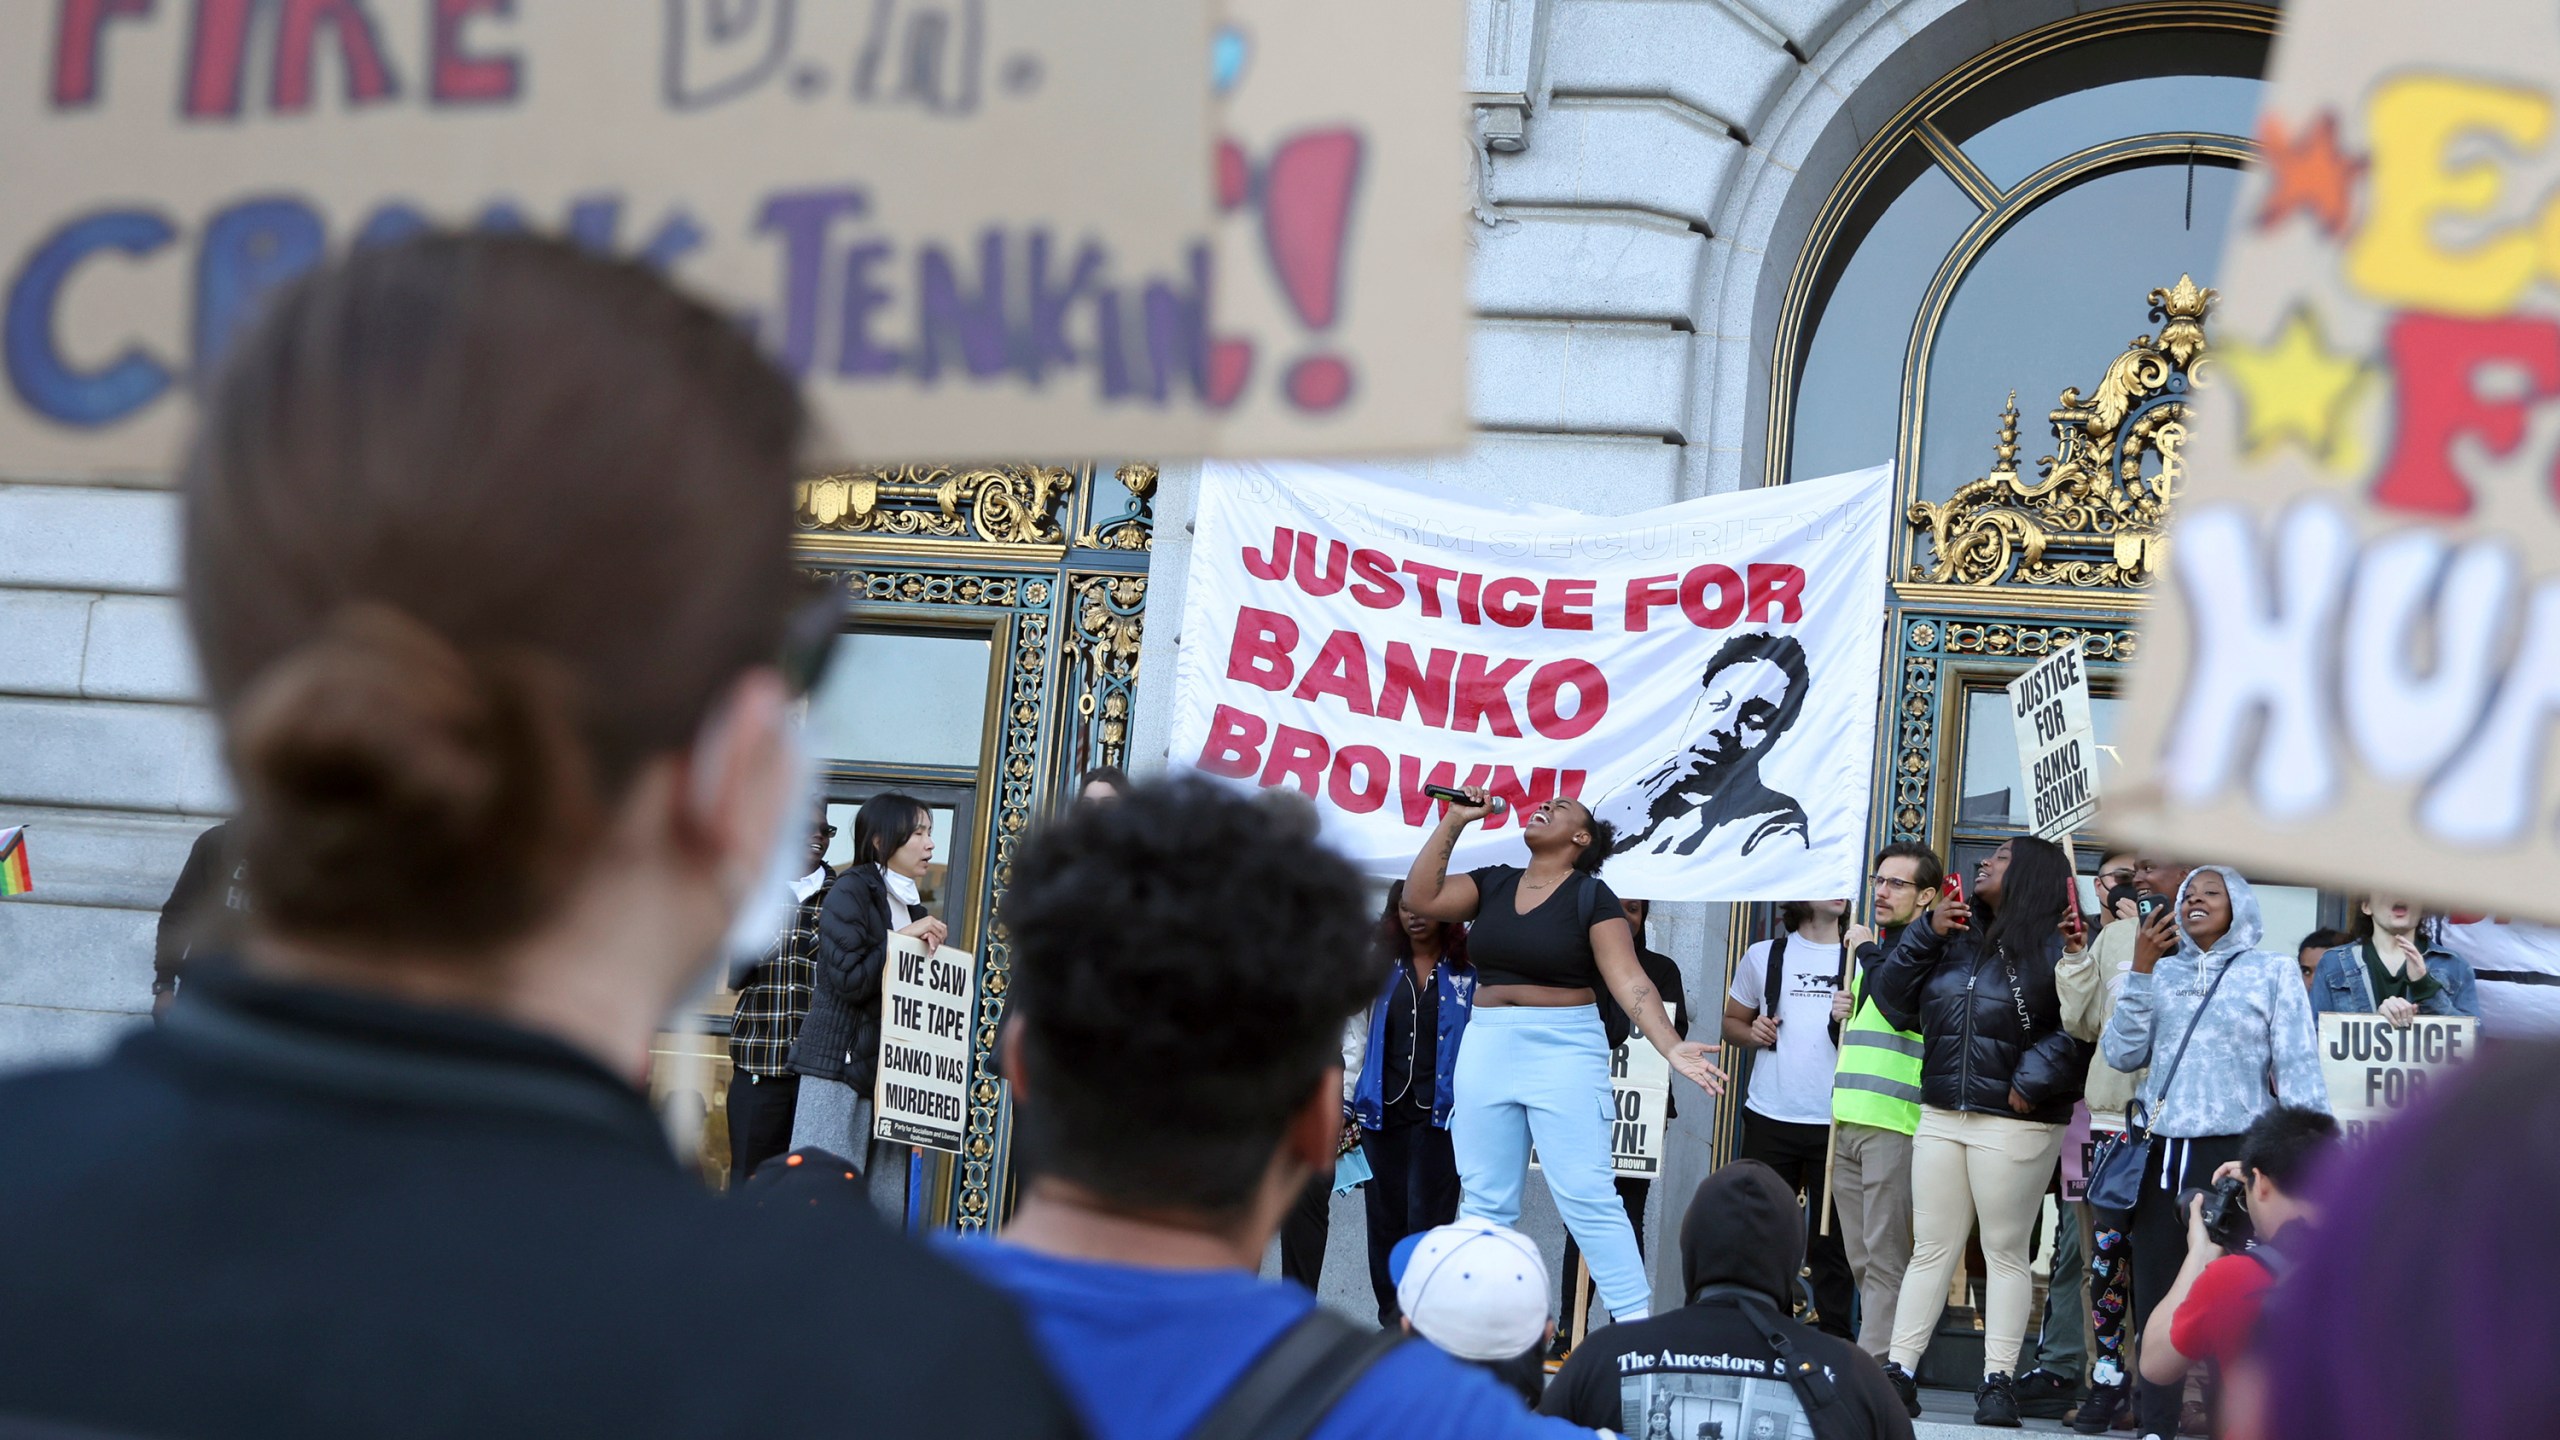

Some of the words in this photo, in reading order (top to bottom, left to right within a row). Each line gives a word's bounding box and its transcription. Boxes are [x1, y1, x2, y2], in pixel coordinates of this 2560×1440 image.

[1237, 468, 1475, 552] DISARM
[1488, 501, 1863, 561] SECURITY!
[1242, 526, 1597, 632] JUSTICE
[1624, 562, 1806, 633] FOR
[1226, 605, 1609, 740] BANKO
[2017, 649, 2080, 718] JUSTICE
[2034, 698, 2066, 747] FOR
[1196, 703, 1587, 831] BROWN!
[2033, 738, 2080, 794] BANKO
[2034, 767, 2092, 828] BROWN!
[898, 950, 925, 987] WE
[929, 959, 966, 997] SAW
[892, 995, 923, 1031] THE
[928, 1003, 965, 1041] TAPE
[884, 1043, 932, 1077] BANKO
[935, 1054, 963, 1084] WAS
[2330, 1021, 2464, 1064] JUSTICE
[885, 1082, 960, 1122] MURDERED
[2365, 1067, 2427, 1110] FOR
[1618, 1158, 1646, 1170] BROWN
[1617, 1351, 1655, 1372] The
[1658, 1349, 1765, 1372] Ancestors
